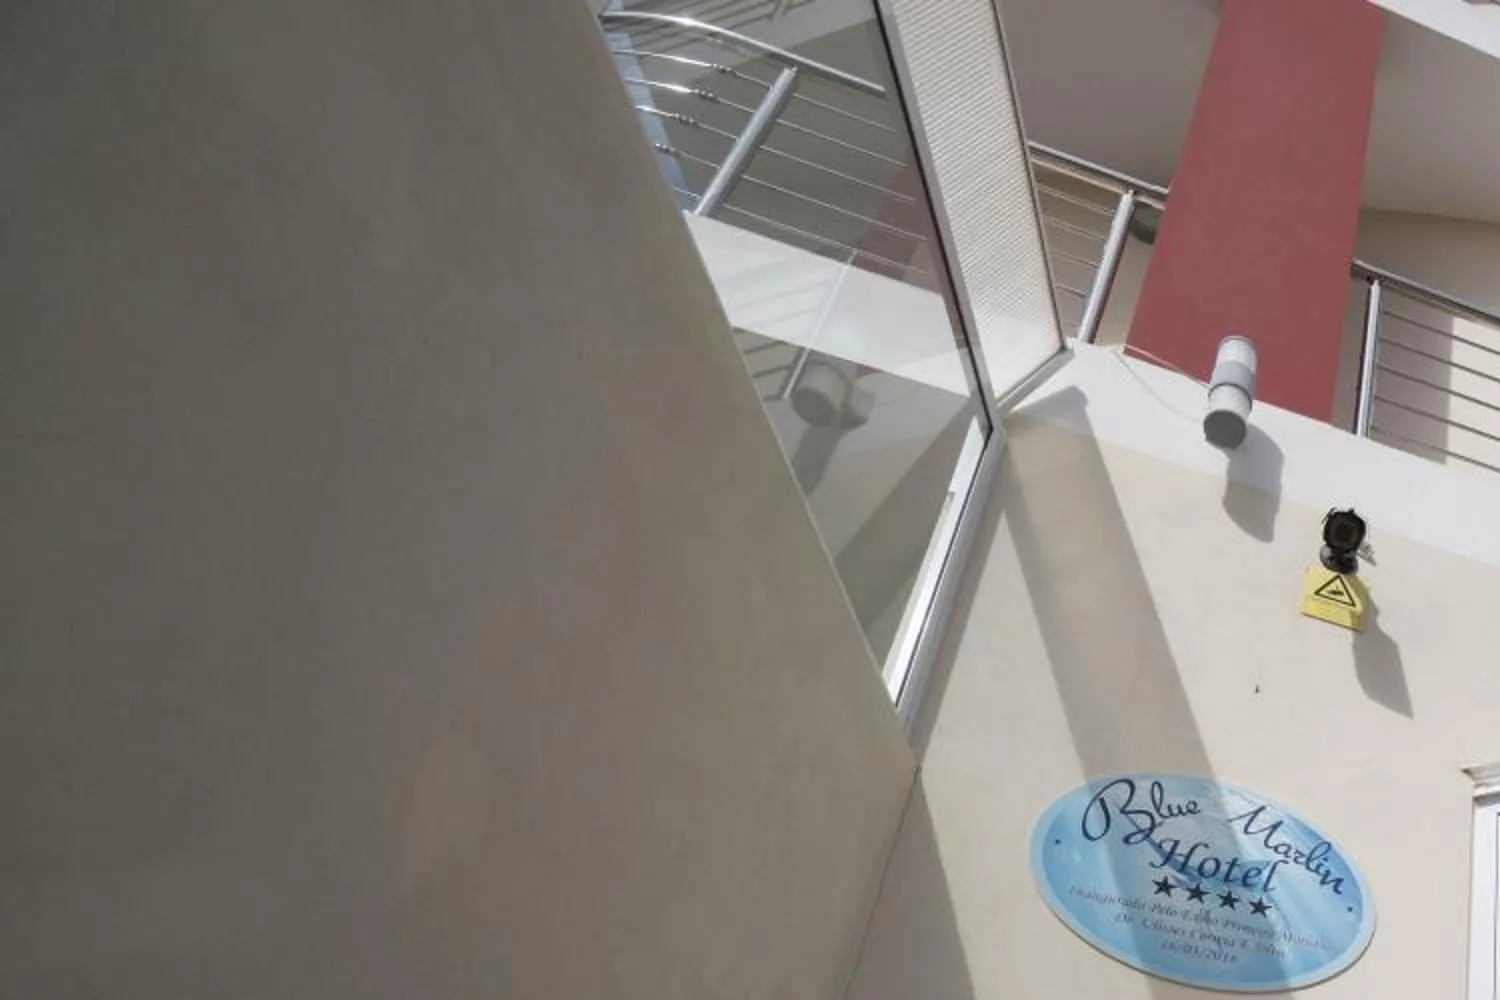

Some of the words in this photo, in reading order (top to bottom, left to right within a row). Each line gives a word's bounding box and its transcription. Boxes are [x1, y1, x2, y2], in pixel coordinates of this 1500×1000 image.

[1081, 778, 1201, 845] Blue
[1228, 804, 1348, 895] Marlin
[1150, 836, 1292, 893] Hotel
